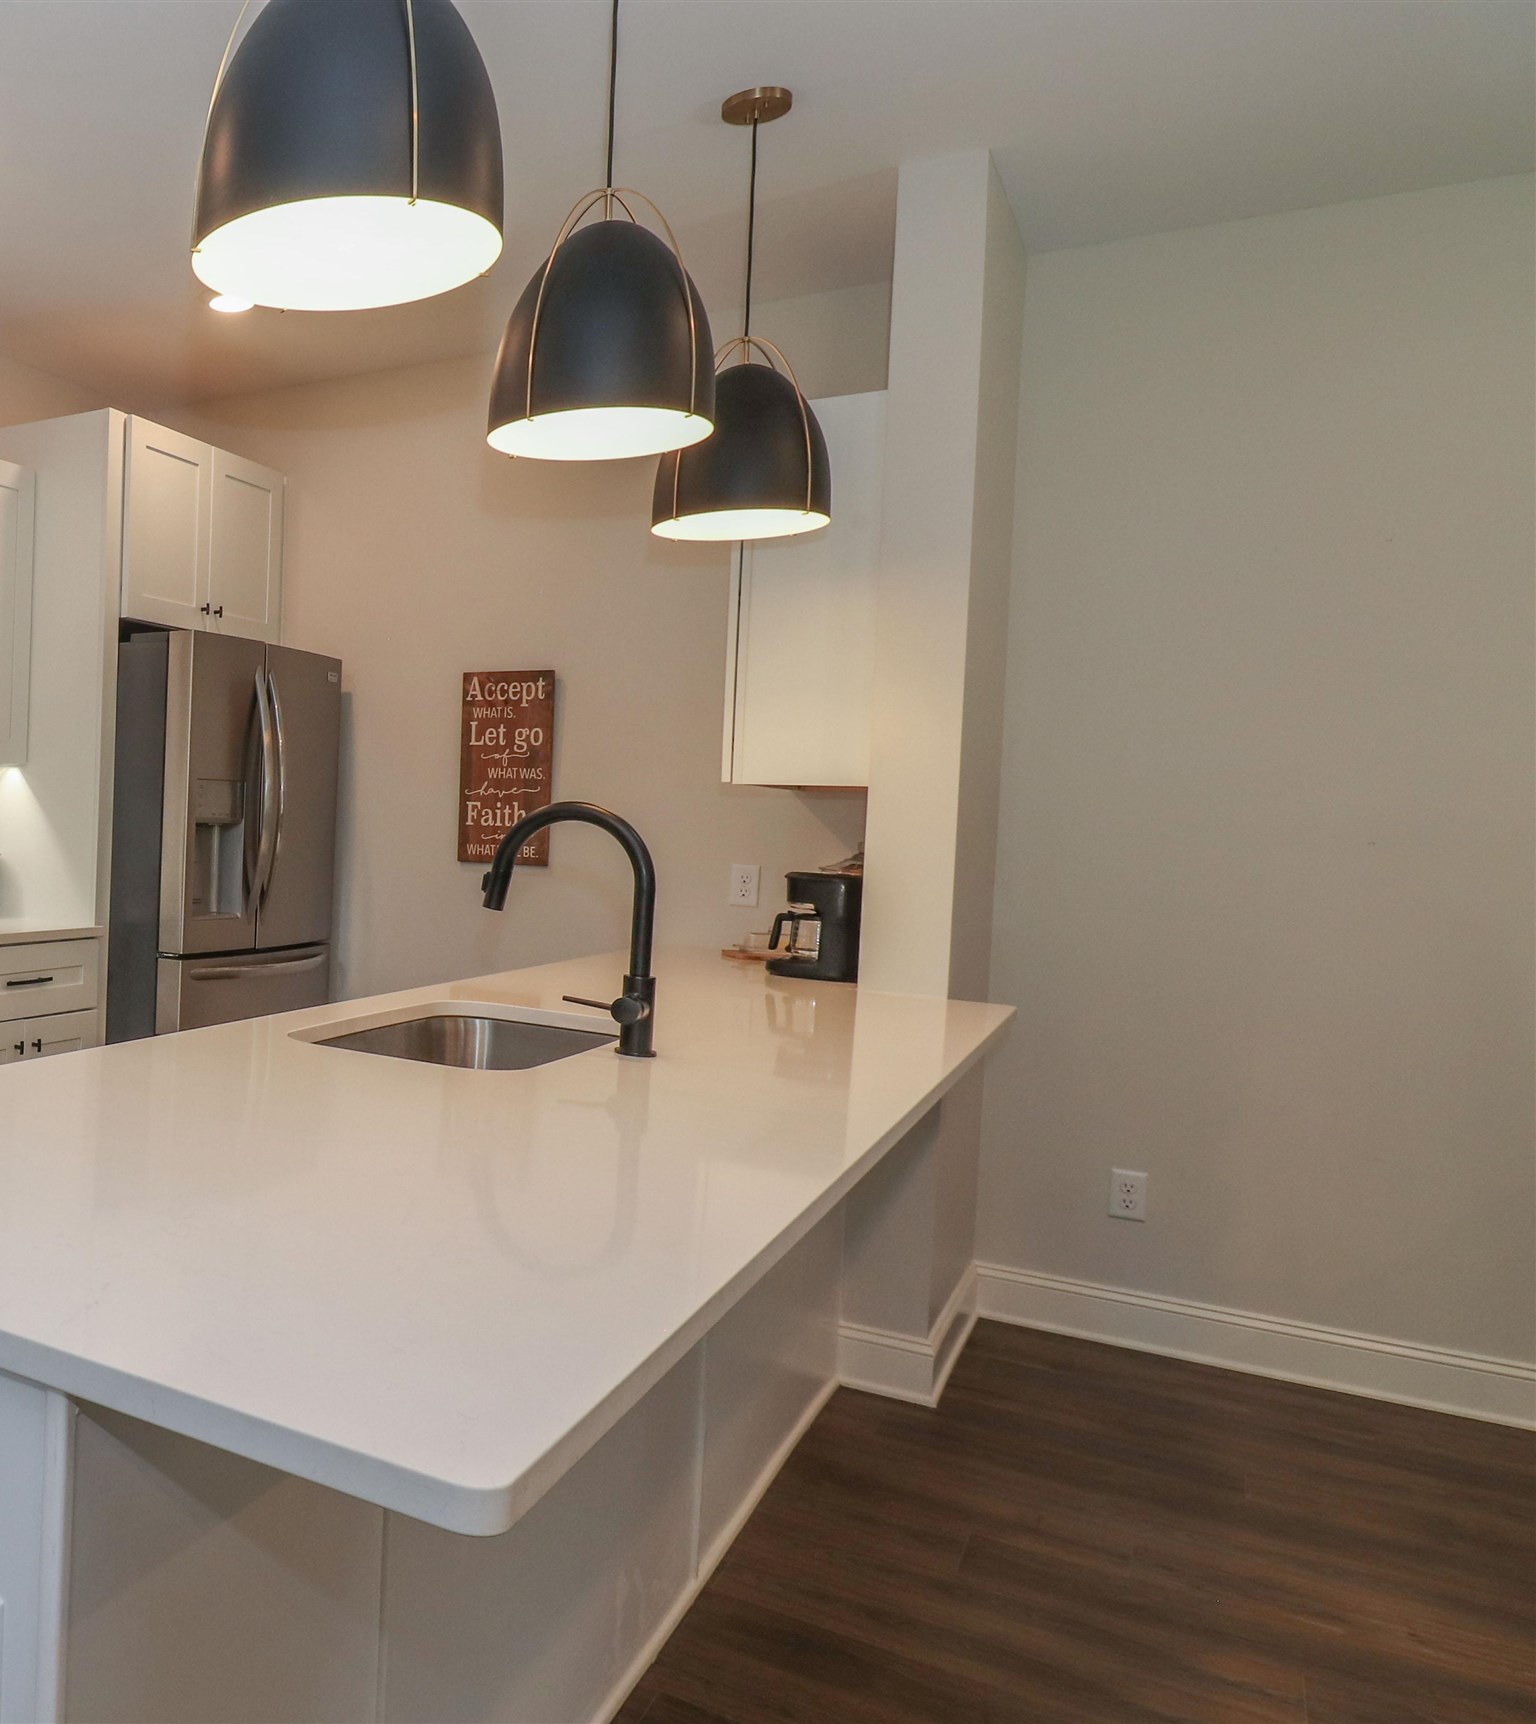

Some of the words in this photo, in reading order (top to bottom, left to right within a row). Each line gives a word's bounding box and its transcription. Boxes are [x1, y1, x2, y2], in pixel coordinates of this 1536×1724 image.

[466, 676, 546, 707] Accept
[473, 707, 503, 719] WHAT
[504, 707, 516, 719] IS.
[469, 722, 506, 746] Let
[514, 727, 544, 752] go
[481, 749, 530, 766] of
[488, 767, 518, 779] WHAT
[519, 767, 546, 780] WAS.
[465, 781, 540, 796] have
[466, 843, 496, 856] WHAT
[523, 846, 539, 858] BE.
